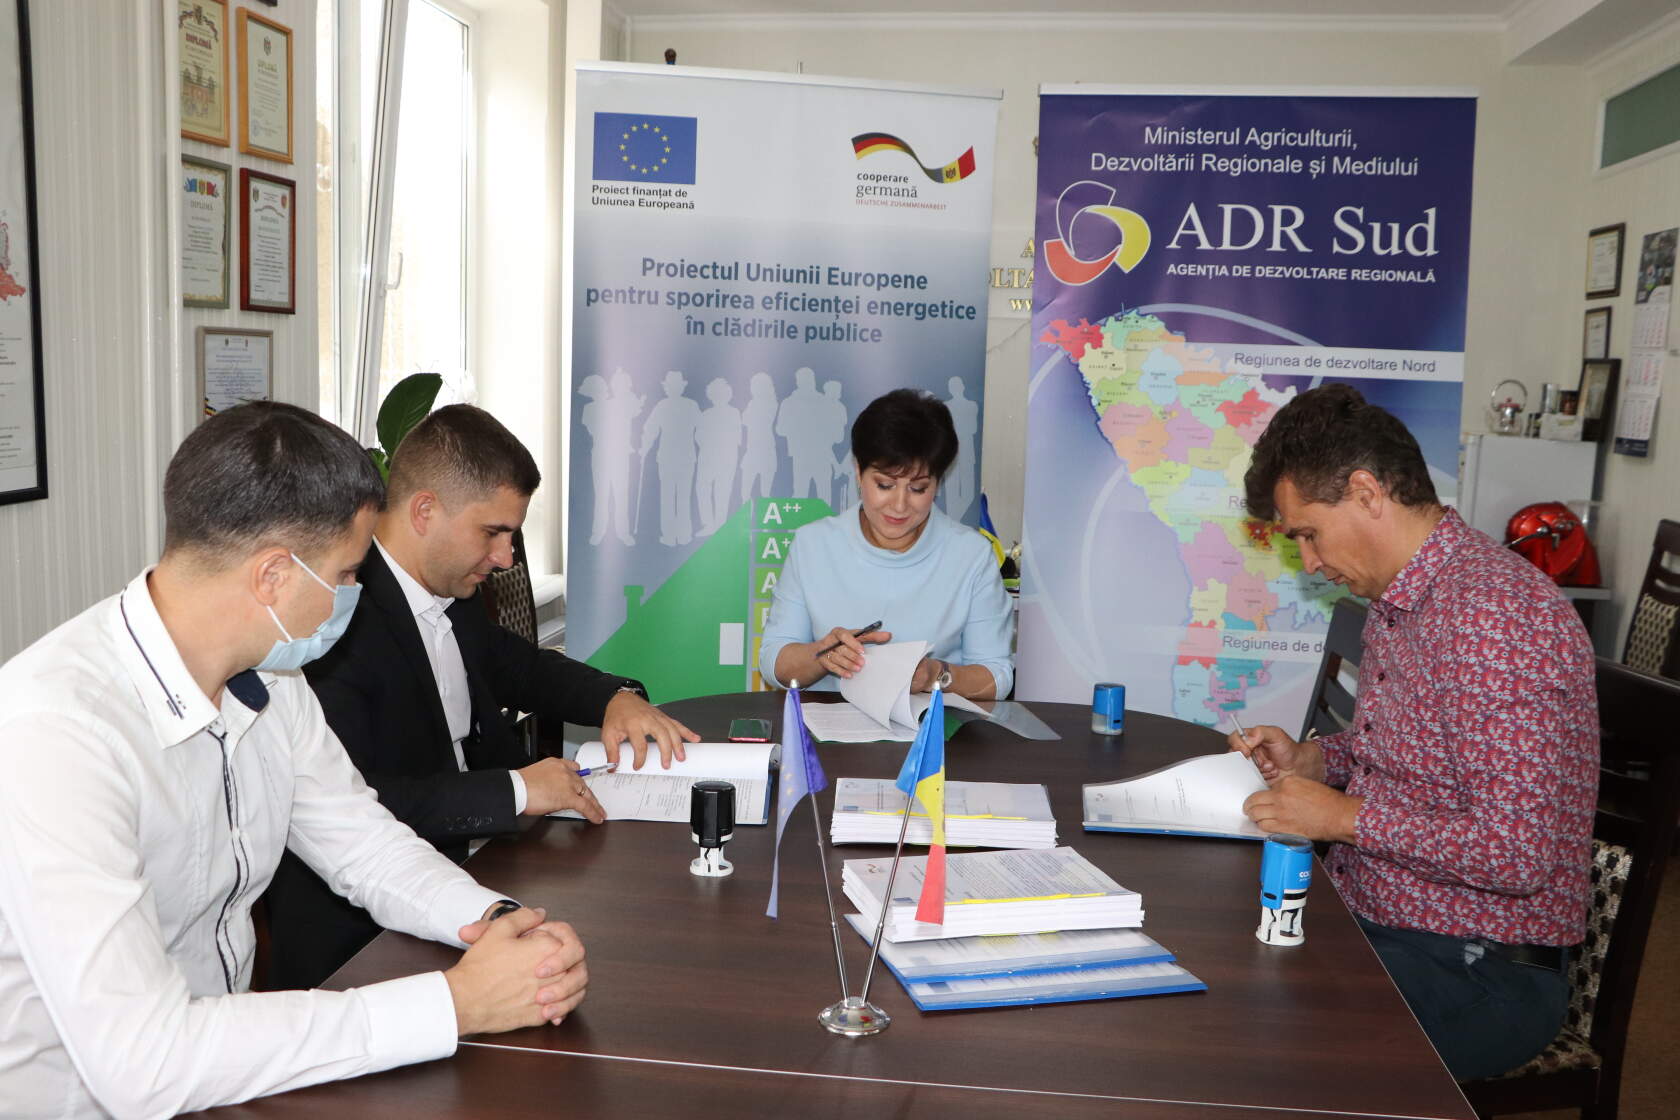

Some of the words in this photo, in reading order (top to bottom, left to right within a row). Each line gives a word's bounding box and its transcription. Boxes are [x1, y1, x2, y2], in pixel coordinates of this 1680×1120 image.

[1144, 126, 1240, 146] Ministerul
[1246, 129, 1358, 150] Agriculturii,
[1091, 152, 1195, 172] Dezvoltării
[1202, 154, 1302, 176] Regionale
[1333, 156, 1418, 176] Mediului
[857, 173, 909, 183] cooperare
[592, 185, 632, 197] Proiect
[674, 187, 688, 198] de
[856, 185, 918, 198] germană
[592, 196, 635, 208] Uniunea
[638, 198, 695, 210] Europeană
[1165, 201, 1312, 254] ADR
[1333, 206, 1439, 257] Sud
[642, 258, 739, 282] Proiectul
[746, 263, 820, 286] Uniunii
[828, 266, 928, 291] Europene
[1167, 263, 1228, 280] AGENȚIA
[1232, 265, 1252, 277] DE
[1255, 266, 1347, 280] DEZVOLTARE
[1351, 267, 1436, 283] REGIONALĂ
[586, 286, 659, 308] pentru
[666, 288, 754, 311] sporirea
[761, 291, 860, 319] eficienței
[867, 298, 976, 322] energetice
[686, 316, 705, 336] în
[712, 317, 798, 340] clădirile
[805, 321, 882, 344] publice
[1234, 352, 1300, 369] Regiunea
[1304, 356, 1322, 368] de
[1326, 356, 1398, 371] dezvoltare
[1402, 358, 1436, 372] Nord
[1223, 635, 1288, 651] Regiunea
[1292, 639, 1311, 653] de
